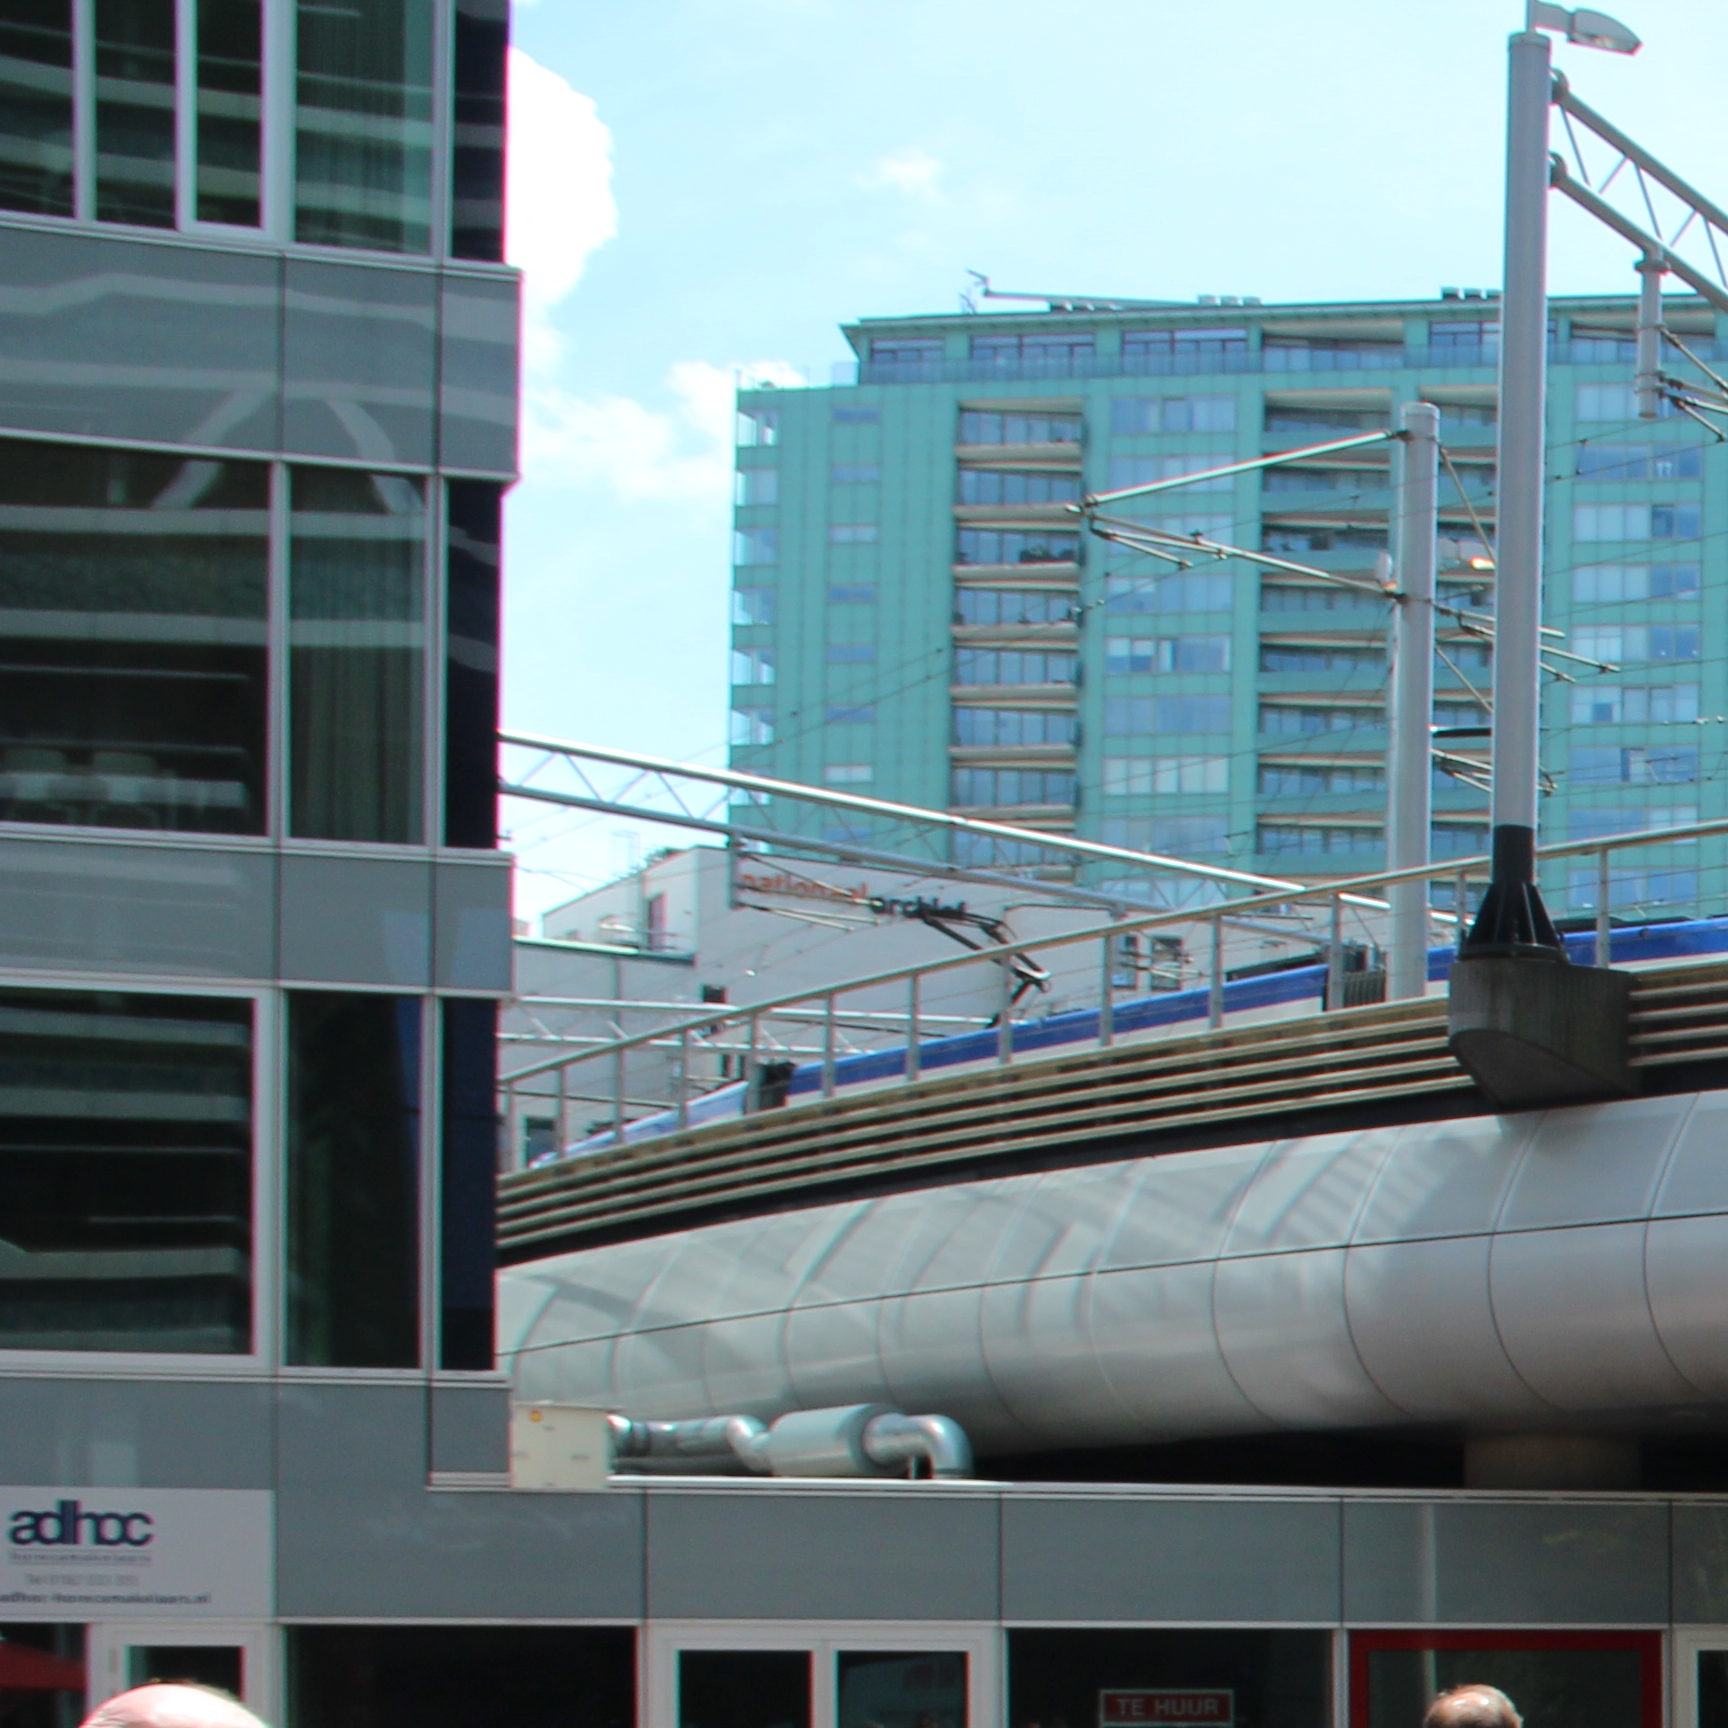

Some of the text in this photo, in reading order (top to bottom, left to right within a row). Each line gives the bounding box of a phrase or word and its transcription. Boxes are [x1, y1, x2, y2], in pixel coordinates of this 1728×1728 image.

[9, 1499, 155, 1546] adhoc
[1116, 1698, 1219, 1716] TE HUUR
